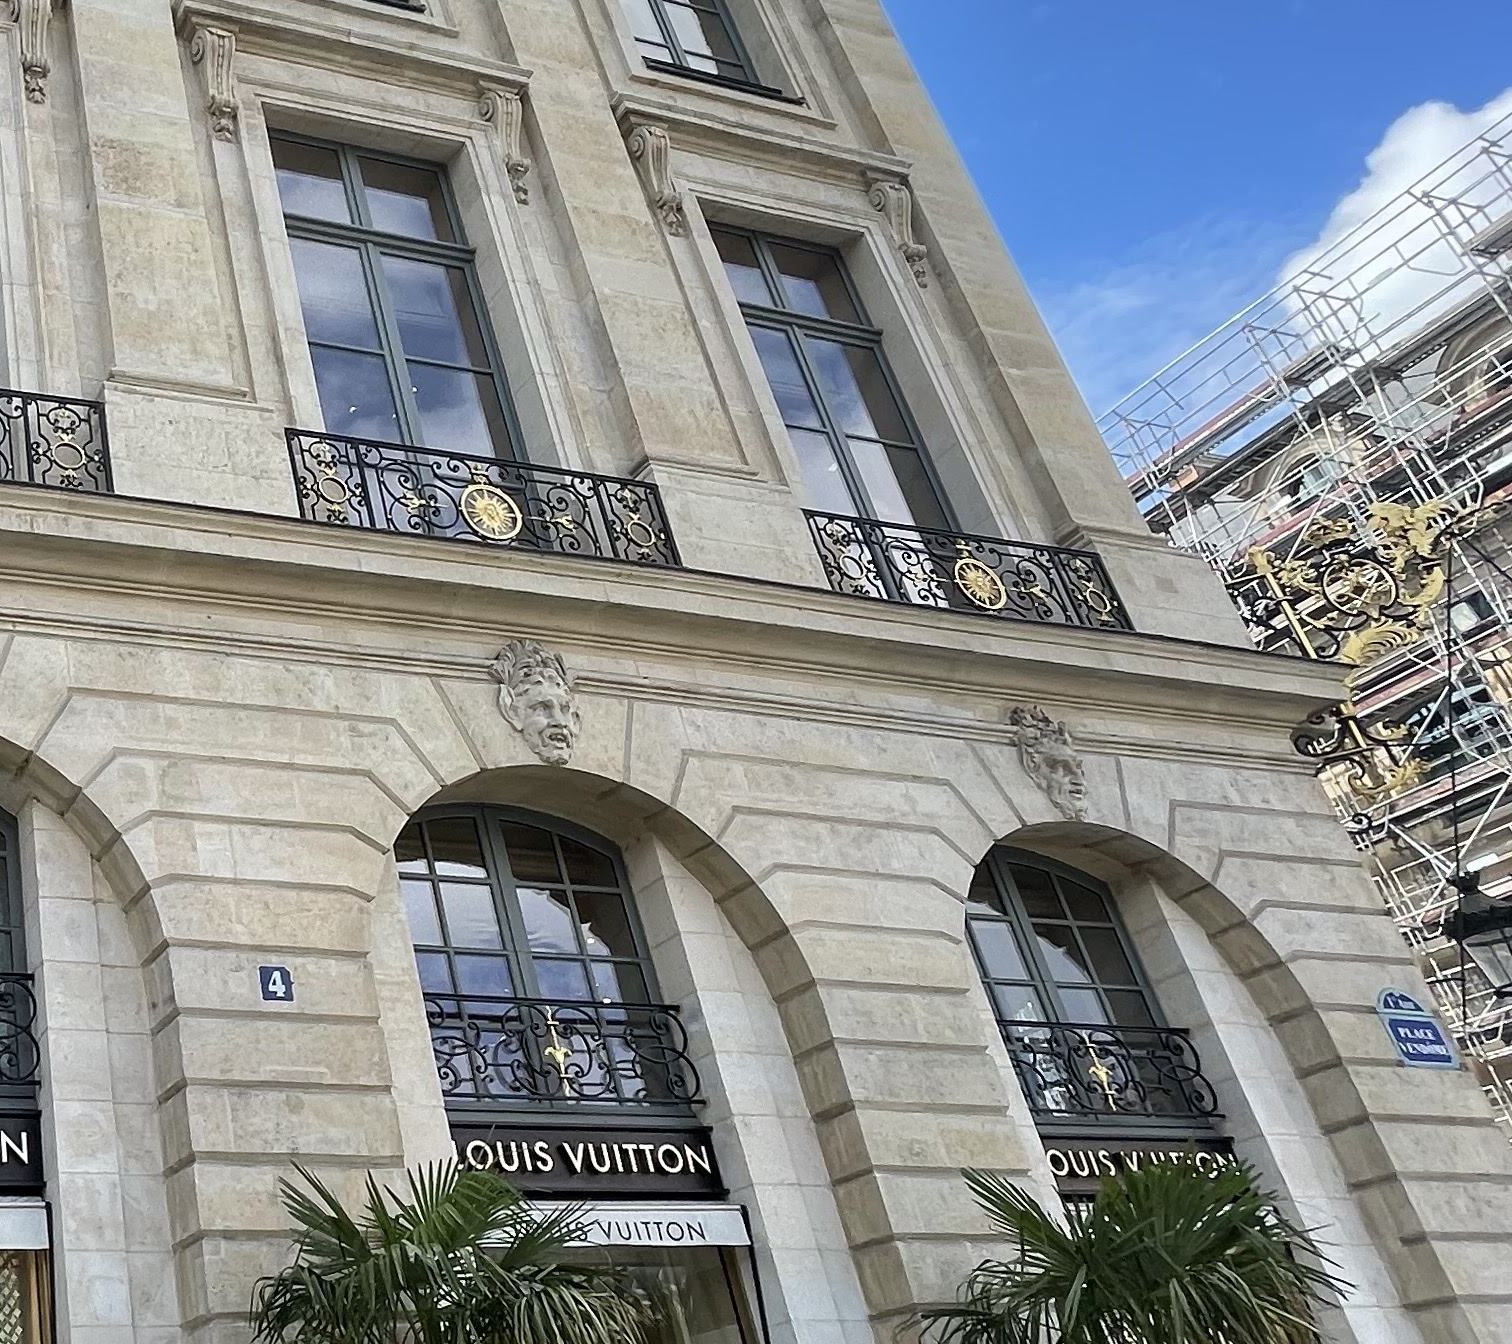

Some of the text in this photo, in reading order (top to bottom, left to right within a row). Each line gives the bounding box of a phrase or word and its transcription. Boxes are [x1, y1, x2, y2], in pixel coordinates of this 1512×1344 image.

[268, 970, 286, 997] 4
[562, 1141, 713, 1174] VUITTON
[1046, 1149, 1116, 1177] OUIS
[596, 1220, 708, 1242] VUITTON
